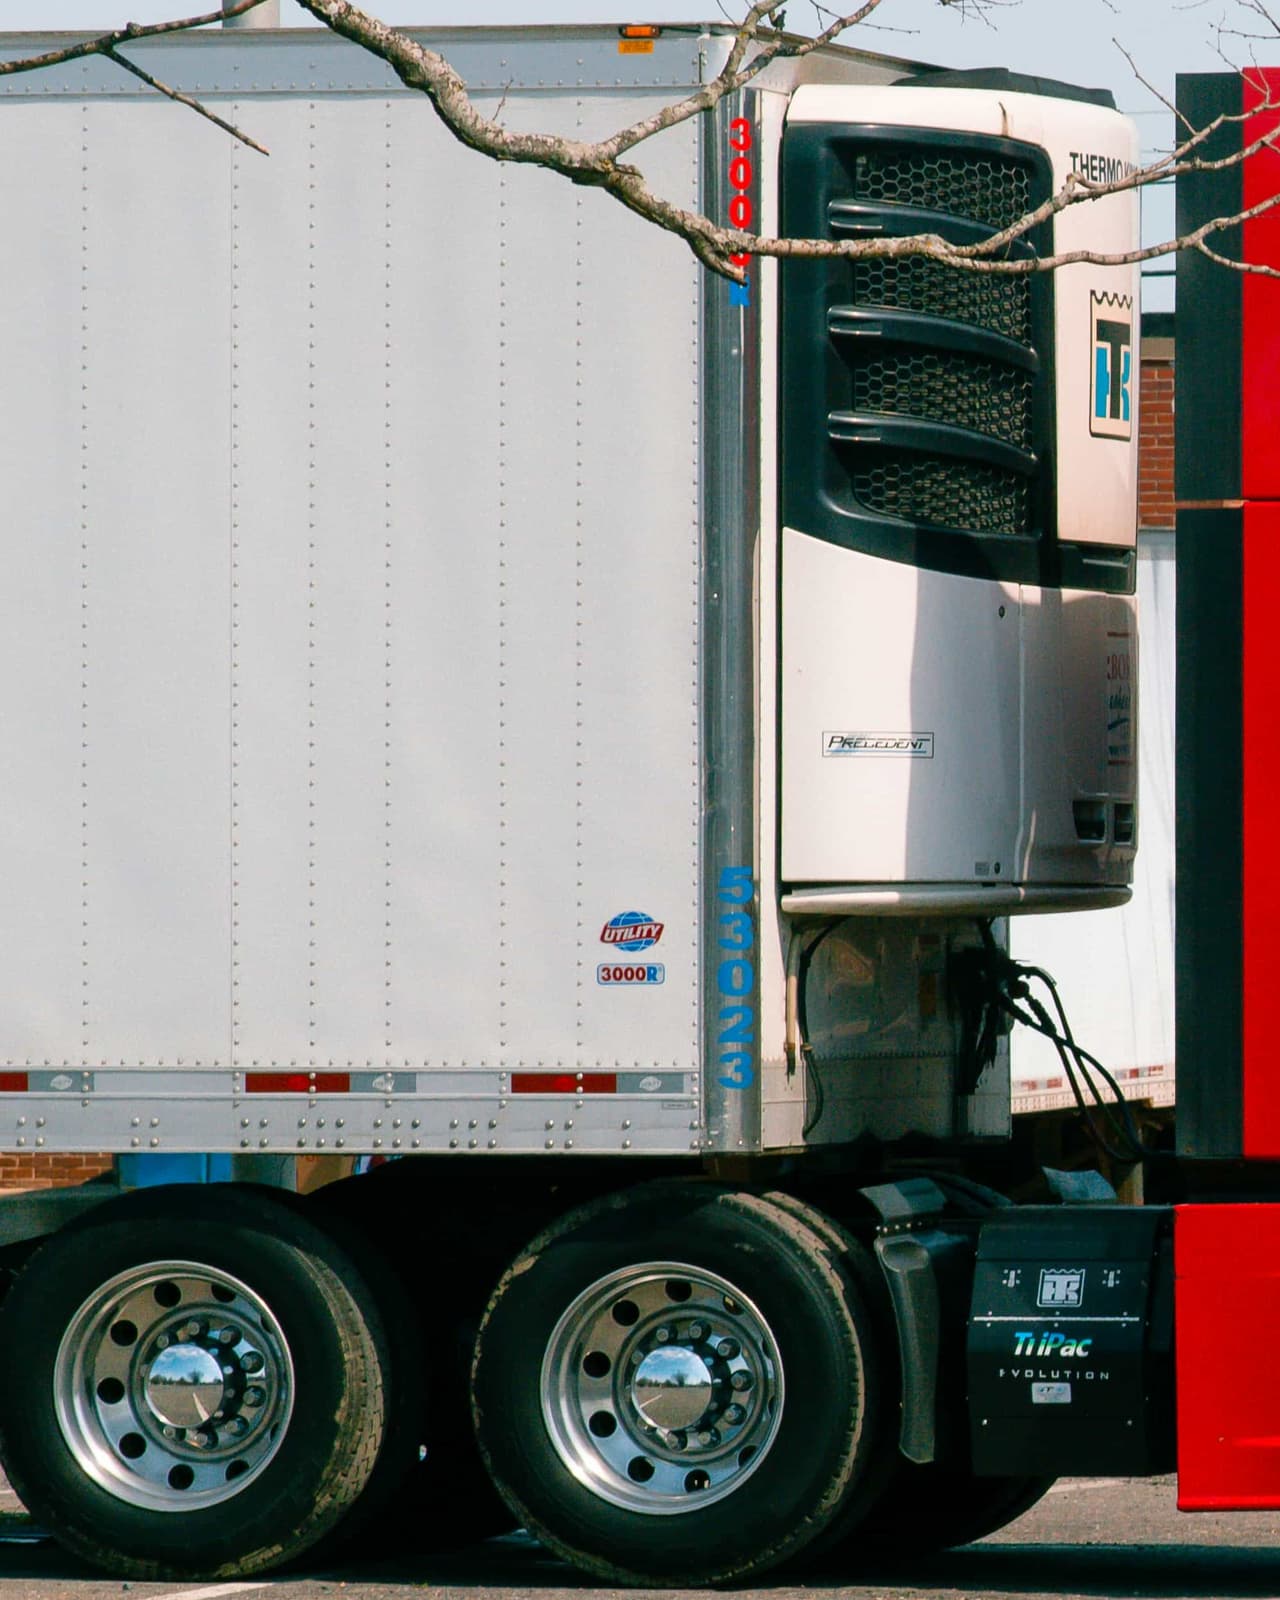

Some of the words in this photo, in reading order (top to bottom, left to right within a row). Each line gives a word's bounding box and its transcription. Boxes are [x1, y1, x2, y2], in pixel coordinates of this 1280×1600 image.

[1069, 152, 1123, 185] THERMO
[828, 735, 931, 749] PRECEDENT
[604, 924, 661, 942] UTILITY
[601, 966, 658, 982] 3000R
[718, 866, 754, 1090] 53023
[1014, 1332, 1092, 1356] TriPac
[1000, 1369, 1109, 1380] EVOLUTION
